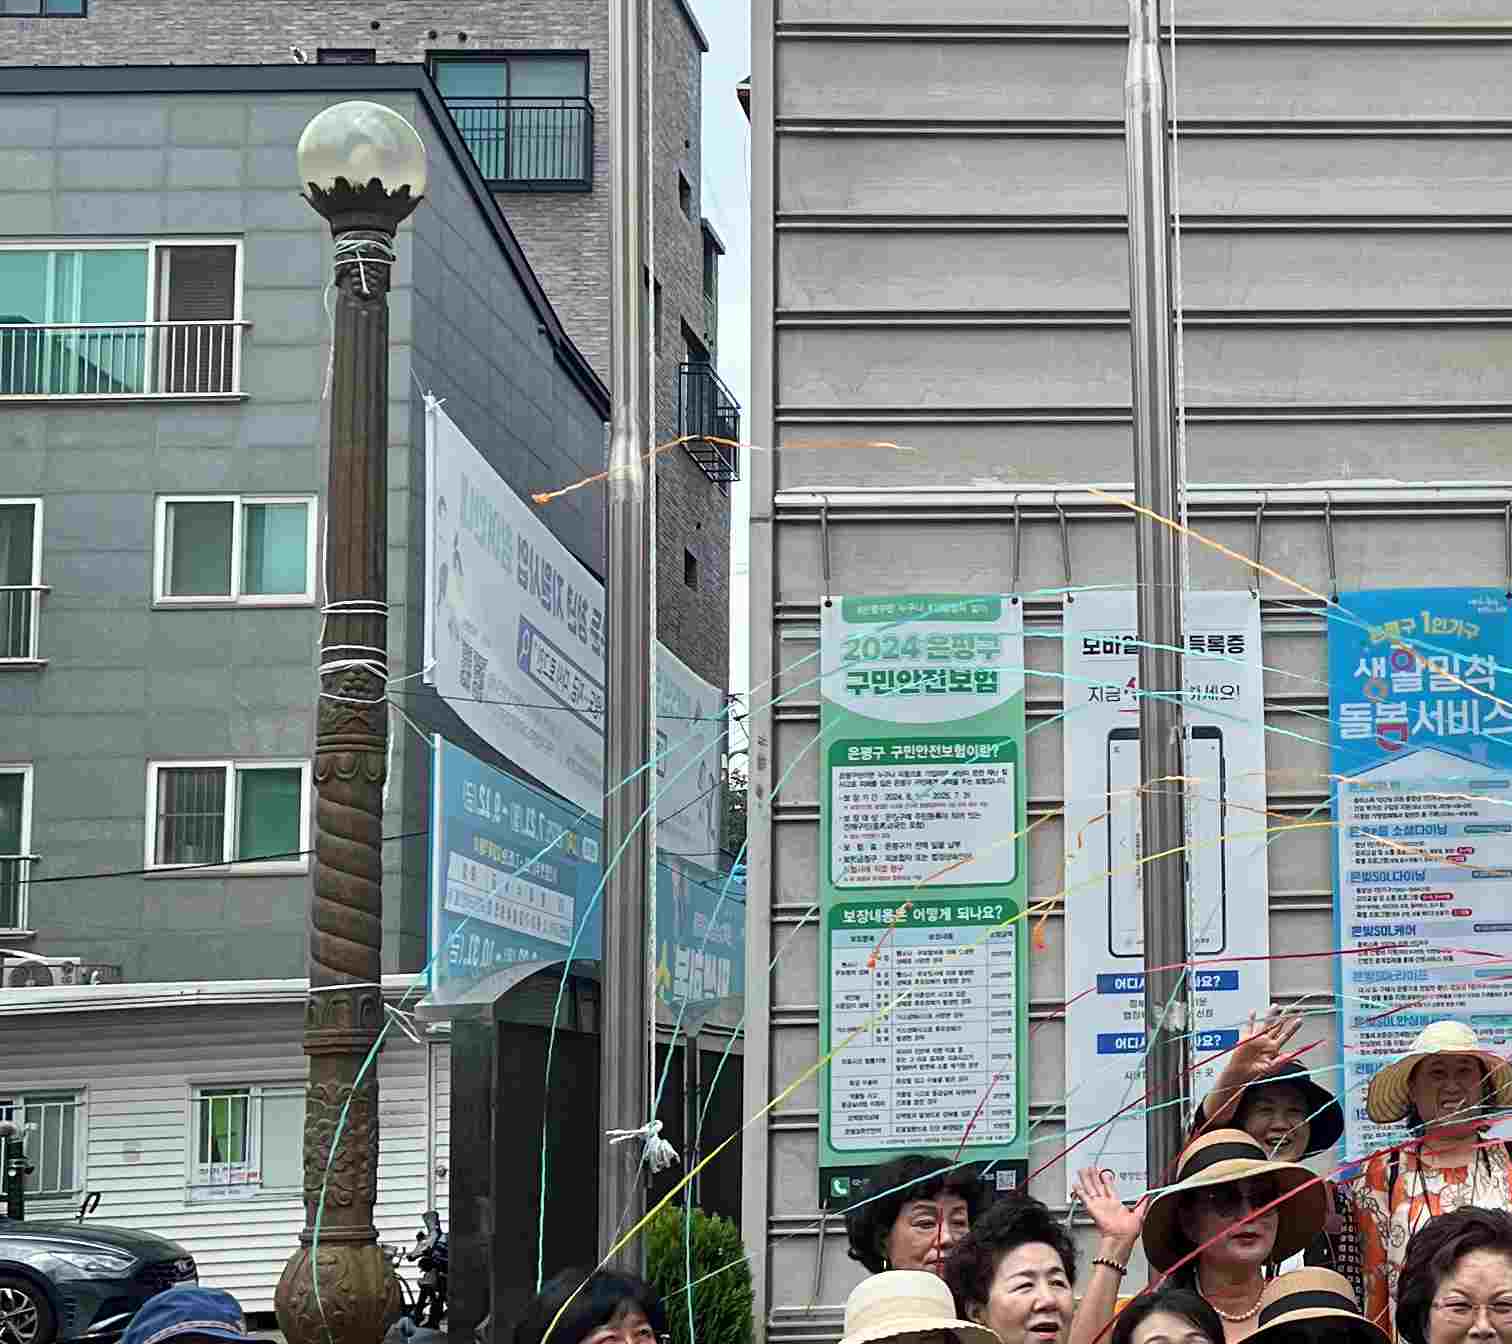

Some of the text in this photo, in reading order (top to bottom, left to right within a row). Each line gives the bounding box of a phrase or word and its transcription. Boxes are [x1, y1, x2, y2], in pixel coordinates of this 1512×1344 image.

[842, 630, 1000, 661] 2024 은평구
[1187, 634, 1246, 655] 등록증
[847, 668, 998, 696] 구민안전보험
[1088, 685, 1121, 703] 지금
[848, 742, 1000, 761] 은평구 구민안전보험이란?
[913, 906, 952, 922] 어떻게
[957, 905, 1003, 920] 되나요?
